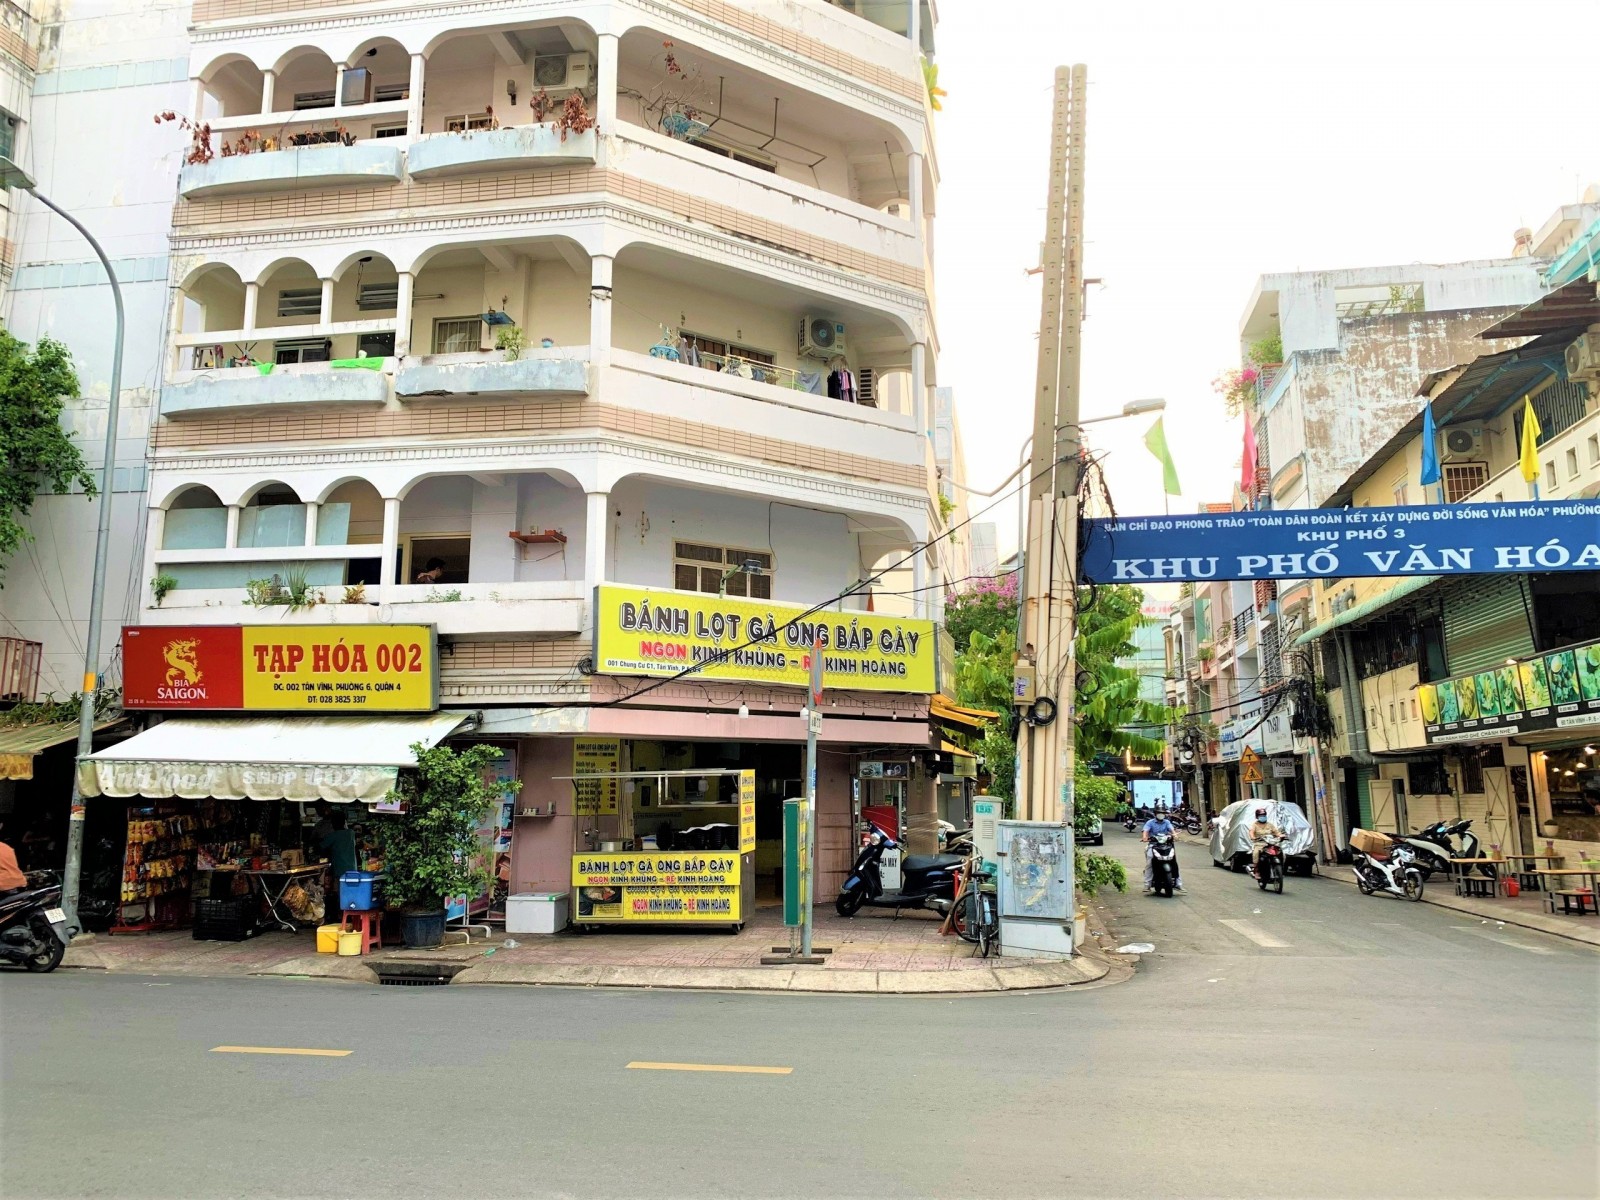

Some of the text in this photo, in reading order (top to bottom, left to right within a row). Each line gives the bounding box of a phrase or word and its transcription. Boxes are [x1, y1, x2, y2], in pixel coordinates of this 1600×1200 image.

[1129, 519, 1148, 531] CHỈ
[1150, 521, 1172, 533] ĐẠO
[1175, 519, 1213, 529] PHONG
[1216, 517, 1245, 528] TRÀO
[1285, 513, 1309, 525] DÂN
[1311, 513, 1342, 524] ĐOÀN
[1345, 510, 1367, 523] KẾT
[1371, 511, 1393, 522] XÂY
[1397, 510, 1430, 524] DỰNG
[1433, 507, 1453, 520] ĐỜI
[1456, 506, 1489, 519] SỐNG
[1492, 506, 1516, 518] VĂN
[1297, 525, 1406, 541] KHU PHỐ 3
[1112, 538, 1600, 579] KHU PHỐ VĂN HÓA
[620, 599, 920, 655] BÁNH LỌT GÀ ONG BẮP CÀY
[252, 637, 423, 680] TẠP HÓA 002
[607, 659, 618, 667] 001
[619, 660, 637, 669] Chung
[656, 663, 667, 671] Tân
[640, 640, 688, 661] NGON
[691, 645, 730, 664] KINH
[734, 646, 786, 669] KHỦNG
[825, 656, 857, 674] KINH
[861, 658, 907, 677] HOÀNG
[157, 687, 206, 699] SAIGON
[286, 682, 300, 691] 002
[301, 681, 315, 691] TÂN
[374, 682, 395, 693] QUẬN
[396, 683, 402, 691] 4
[307, 695, 367, 704] ĐT: 028 3825 3317
[242, 769, 297, 785] SHOP
[578, 857, 735, 876] BÁNH LỌT GÀ ONG BẮP CÀY
[587, 876, 610, 885] NGON
[610, 876, 630, 885] KINH
[630, 874, 658, 885] KHỦNG
[677, 875, 696, 884] KINH
[698, 874, 726, 884] HOÀNG
[632, 898, 648, 913] NGON
[649, 898, 663, 913] KINH
[696, 898, 711, 913] KINH
[711, 896, 731, 913] HOÀNG
